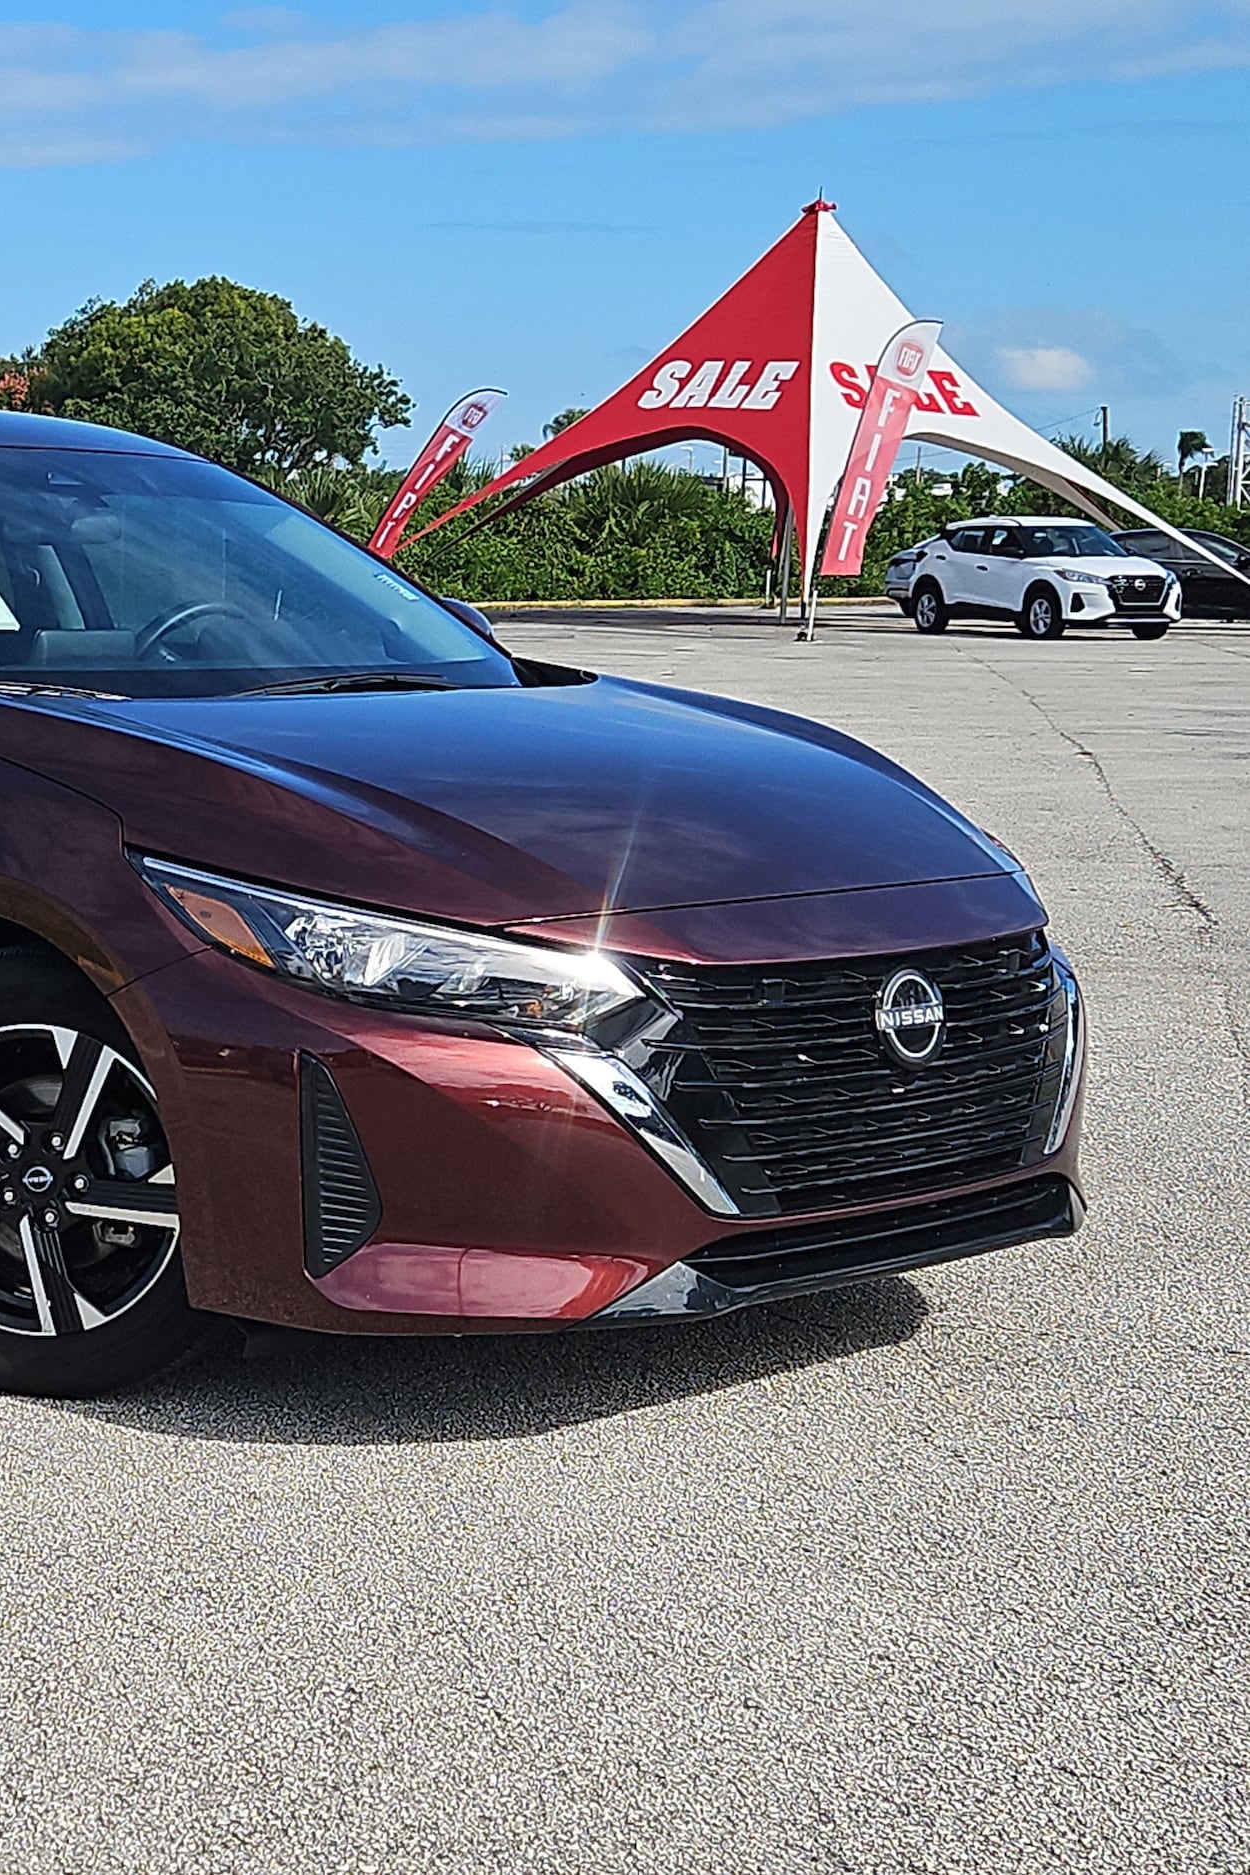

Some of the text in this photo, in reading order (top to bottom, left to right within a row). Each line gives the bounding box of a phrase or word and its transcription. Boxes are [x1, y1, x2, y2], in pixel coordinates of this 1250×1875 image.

[637, 359, 800, 410] SALE
[829, 361, 981, 418] SLE
[837, 387, 902, 562] FIAT
[878, 1005, 944, 1028] NISSAN
